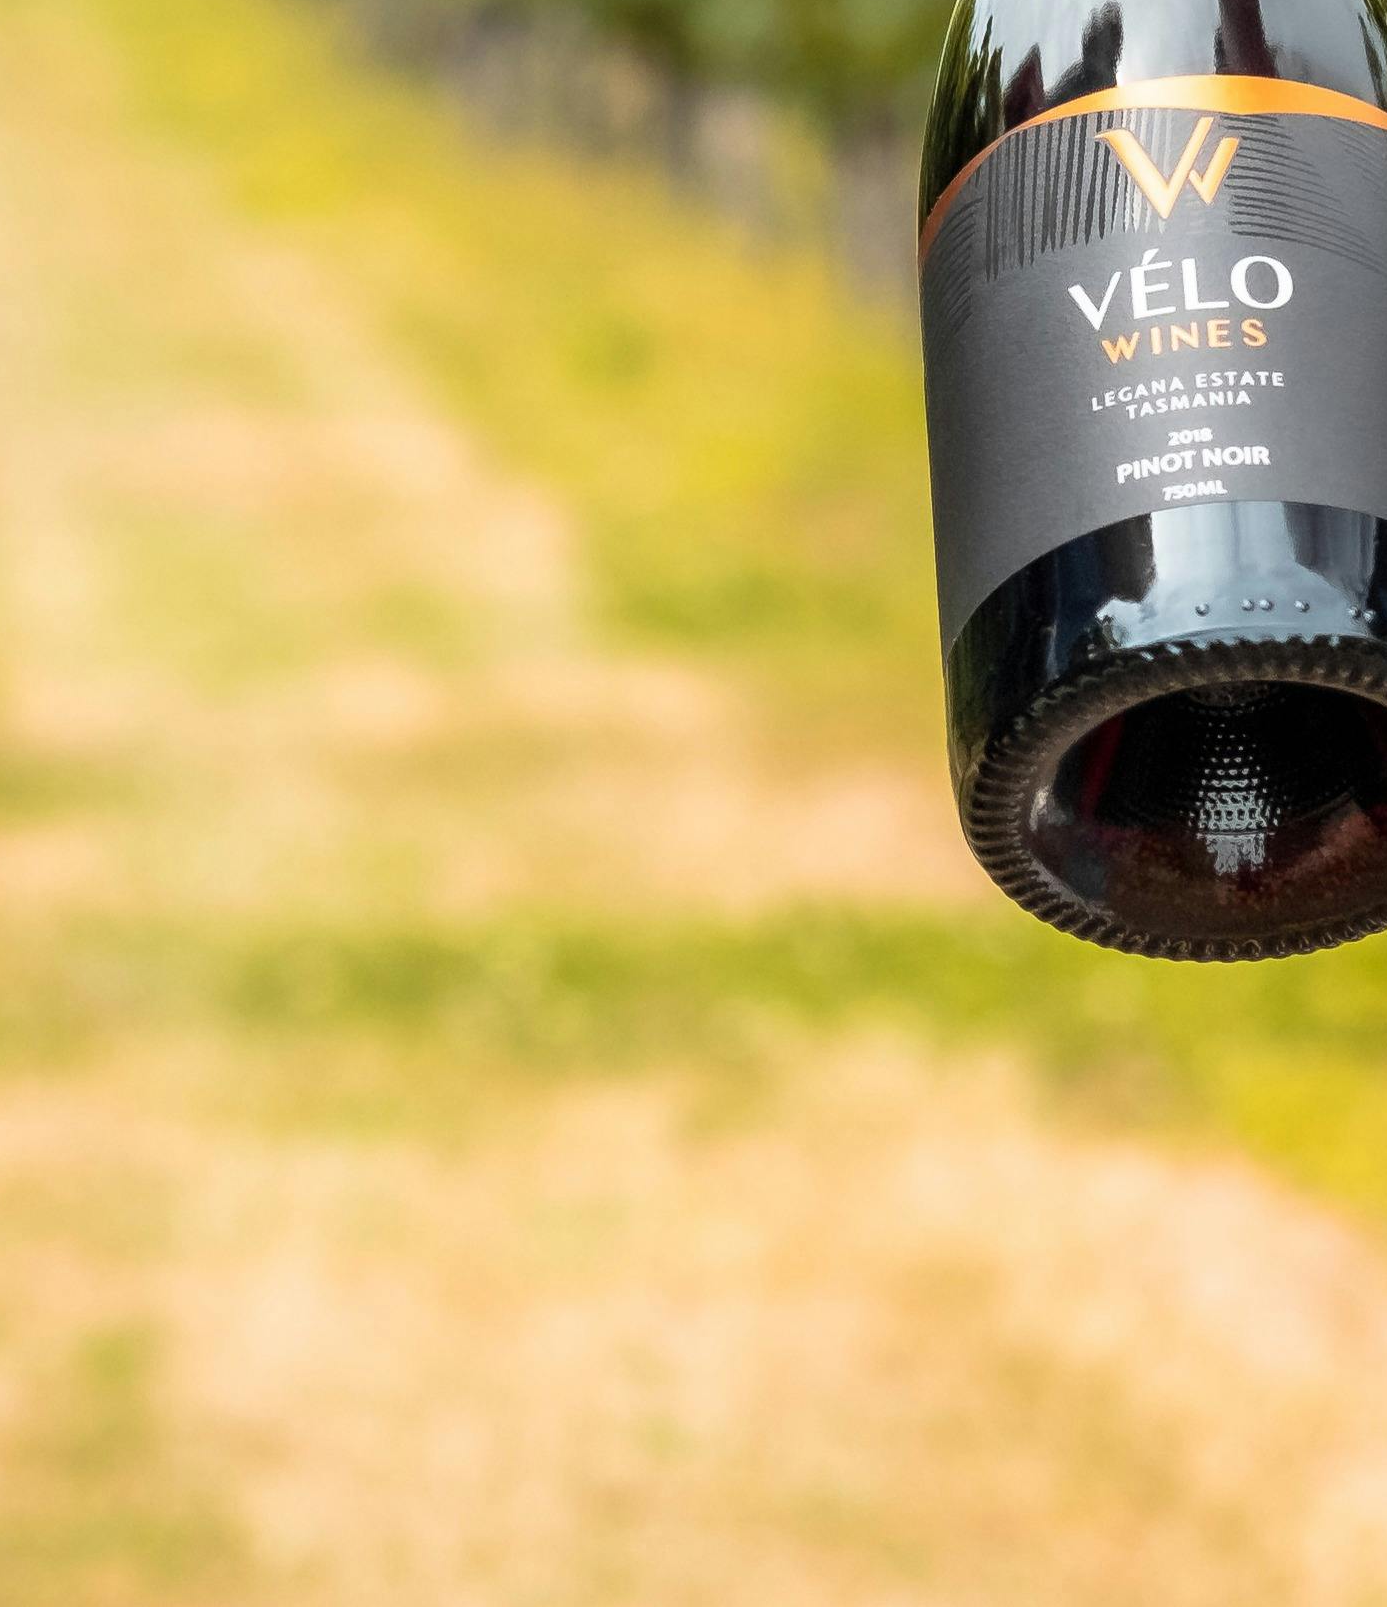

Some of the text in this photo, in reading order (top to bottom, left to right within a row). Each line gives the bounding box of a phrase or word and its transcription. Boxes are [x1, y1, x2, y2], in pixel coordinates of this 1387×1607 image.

[1067, 248, 1294, 331] VÉLO
[1100, 318, 1269, 365] WINES
[1090, 370, 1285, 412] LEGANA ESTATE
[1125, 389, 1252, 420] TASMANIA
[1116, 445, 1271, 484] PINOT NOIR
[1162, 480, 1227, 502] 750ML
